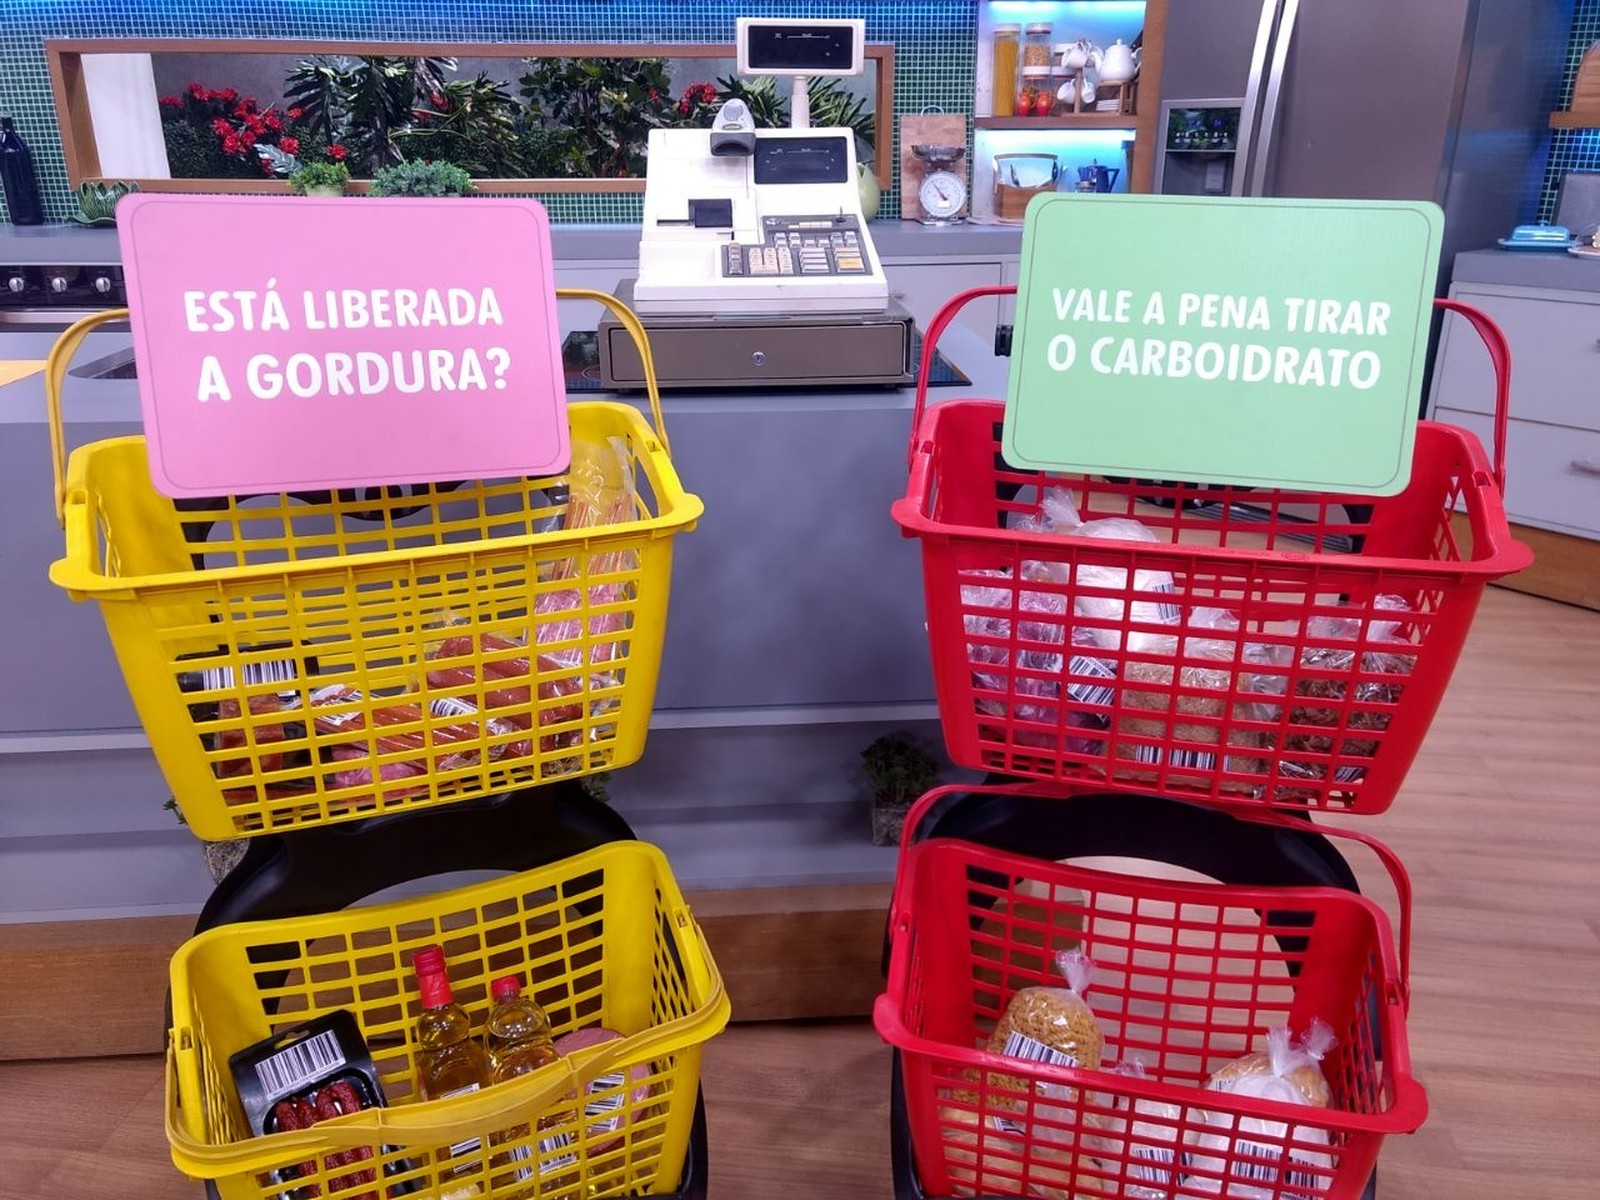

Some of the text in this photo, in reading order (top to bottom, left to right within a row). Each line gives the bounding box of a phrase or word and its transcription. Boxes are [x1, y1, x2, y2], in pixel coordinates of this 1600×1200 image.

[184, 278, 503, 332] ESTÁ LIBERADA
[1051, 287, 1391, 336] VALE A PENA TIRAR
[197, 347, 511, 402] A GORDURA?
[1047, 334, 1381, 390] O CARBOIDRATO
